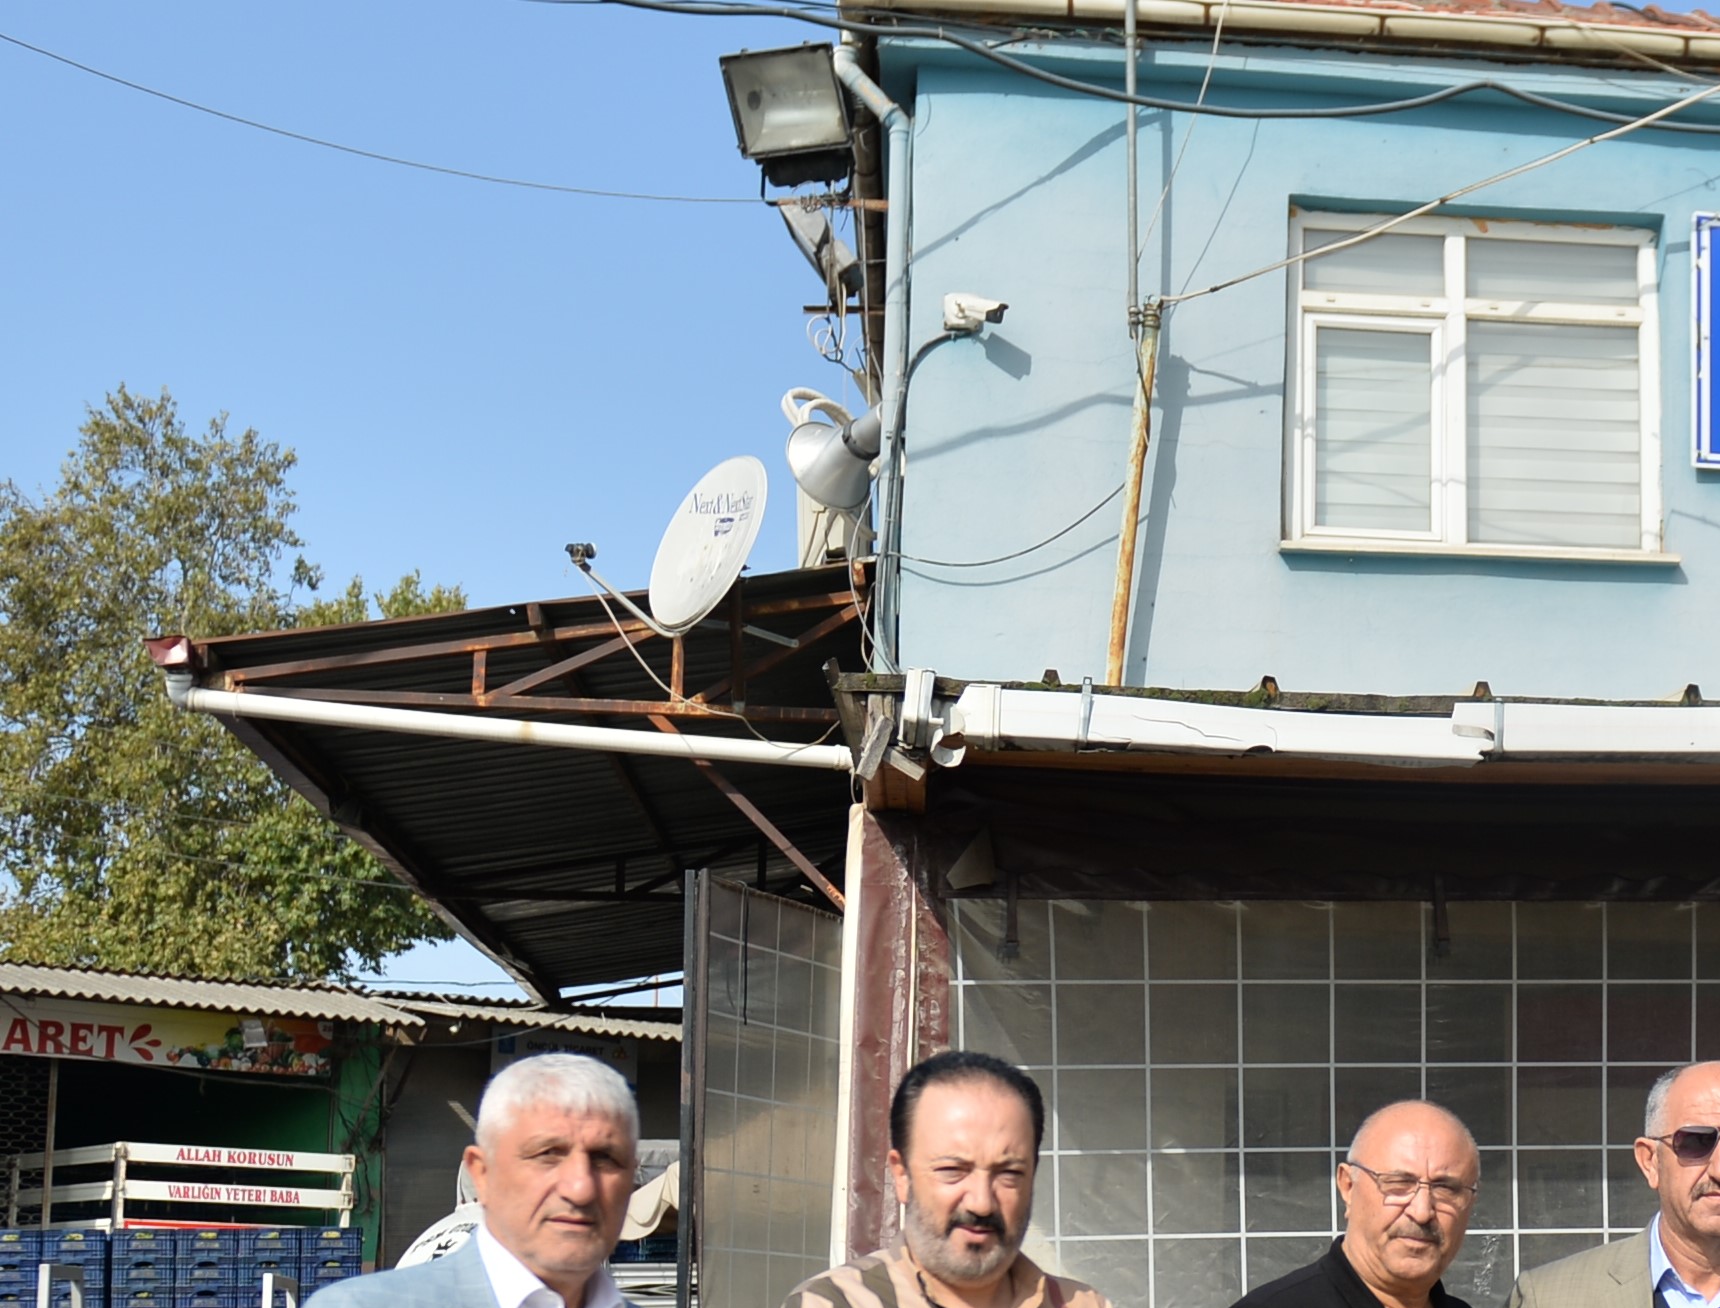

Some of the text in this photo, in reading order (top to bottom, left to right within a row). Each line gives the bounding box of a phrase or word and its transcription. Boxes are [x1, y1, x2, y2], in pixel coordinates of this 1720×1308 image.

[2, 1017, 125, 1060] ARET
[176, 1147, 294, 1167] ALLAH KORUSUN
[168, 1184, 300, 1204] VARLIĞIN YETER! BABA
